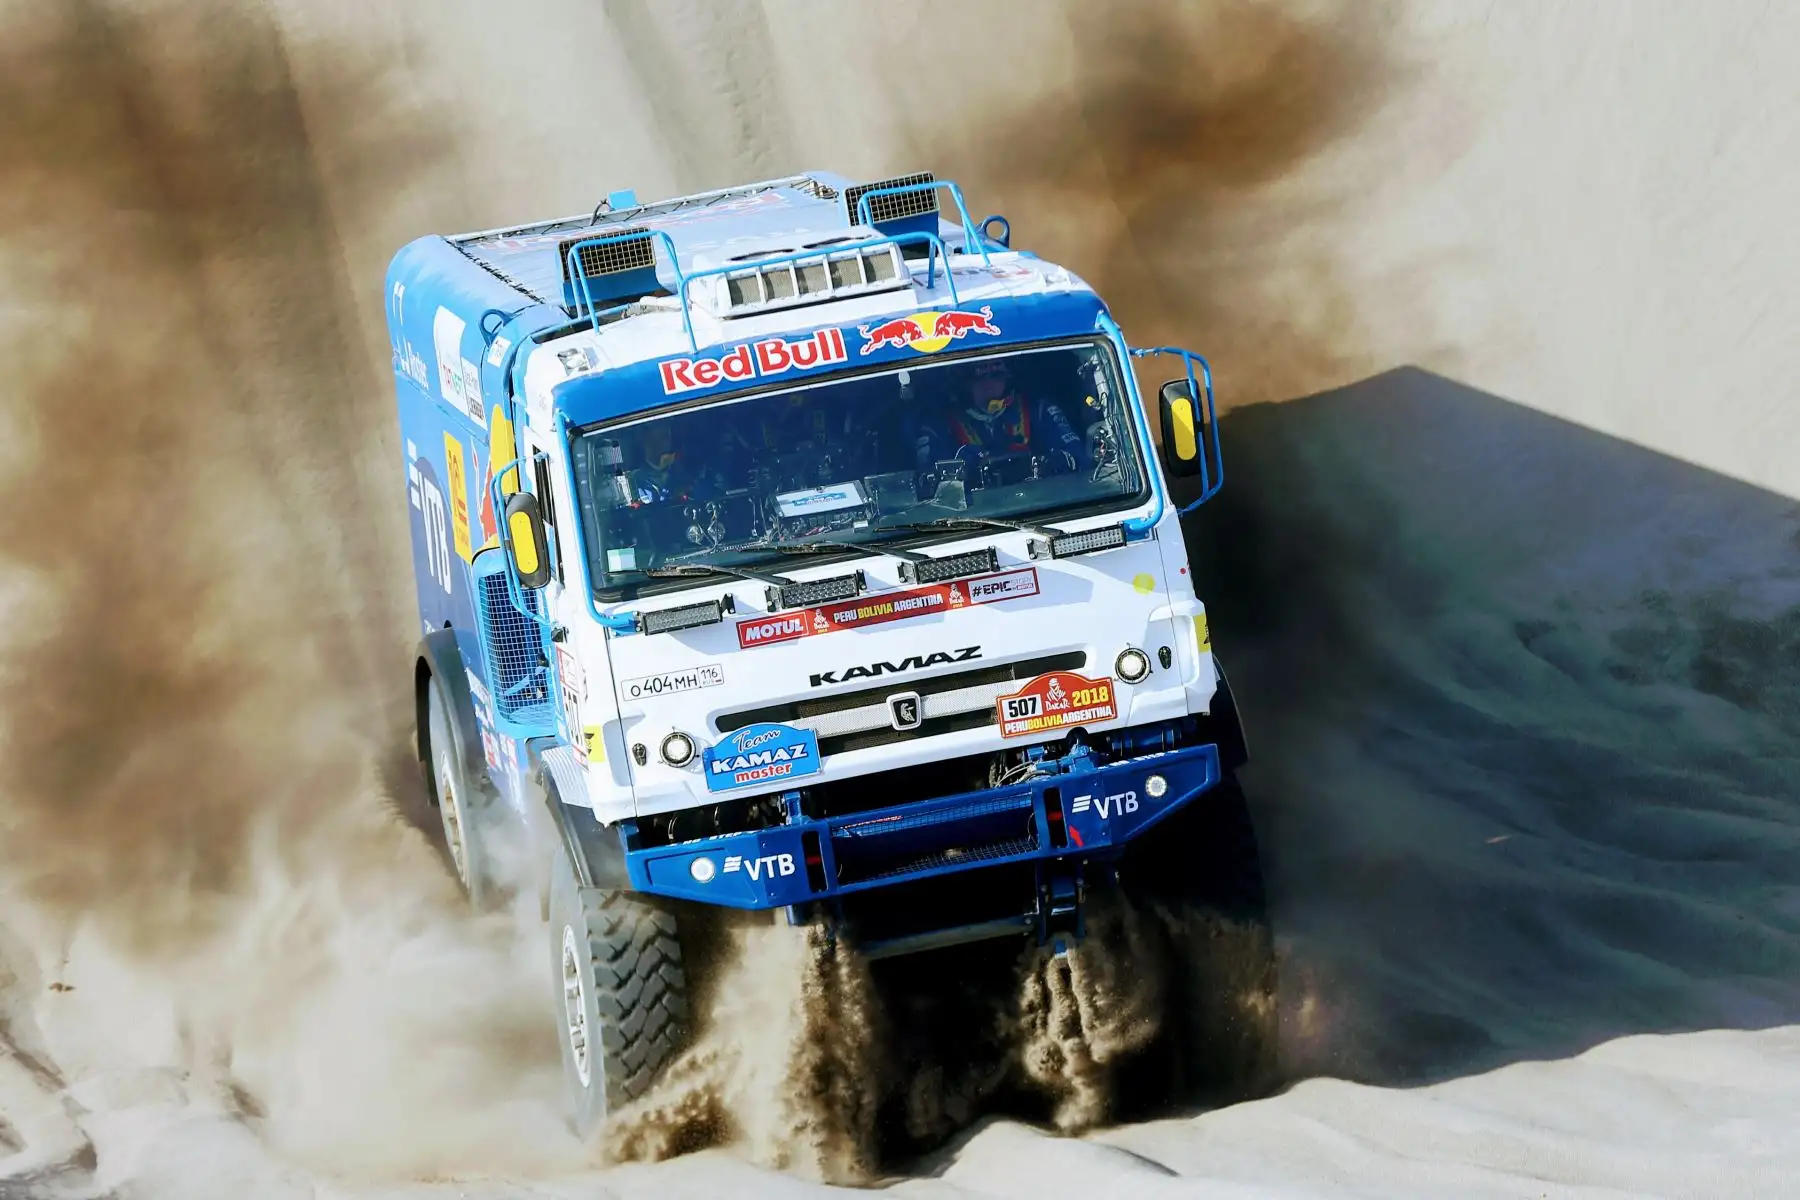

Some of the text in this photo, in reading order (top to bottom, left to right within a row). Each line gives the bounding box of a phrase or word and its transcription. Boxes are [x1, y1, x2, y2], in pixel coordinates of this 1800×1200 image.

[660, 328, 847, 393] Red Bull
[833, 609, 857, 623] PERU
[857, 603, 893, 619] BOLIVIA
[894, 593, 944, 612] ARGENTINA
[745, 619, 804, 641] MOTUL
[809, 645, 983, 687] KAMAZ
[1008, 697, 1037, 718] 507
[1071, 686, 1109, 707] 2018
[732, 729, 781, 752] Team
[712, 744, 808, 774] KAMAZ
[735, 763, 792, 782] master
[1093, 790, 1139, 820] VTB
[743, 853, 796, 881] VTB
